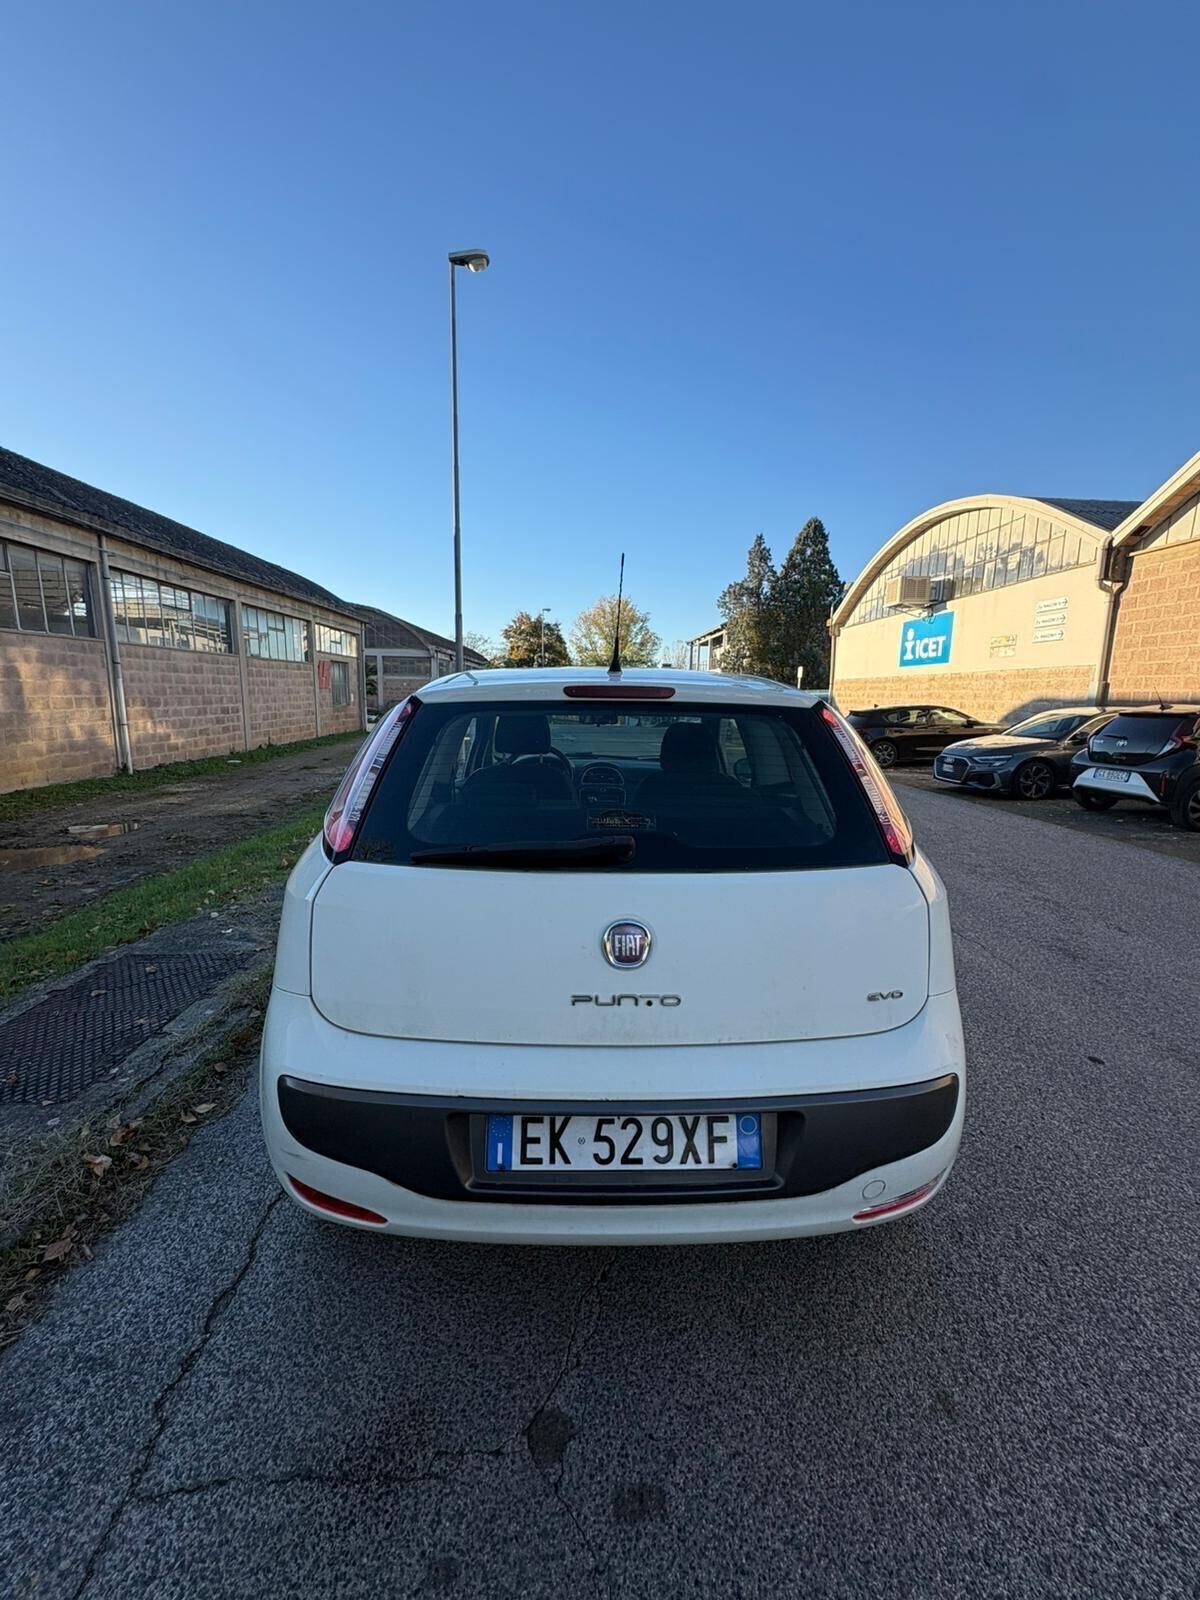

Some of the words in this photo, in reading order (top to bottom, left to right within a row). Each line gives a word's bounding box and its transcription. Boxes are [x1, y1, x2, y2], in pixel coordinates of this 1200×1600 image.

[915, 635, 947, 659] ICET
[614, 934, 642, 957] FIAT
[571, 994, 682, 1007] PUNTO
[867, 990, 904, 1002] EVO
[520, 1116, 572, 1166] EK
[592, 1115, 730, 1166] 529XF
